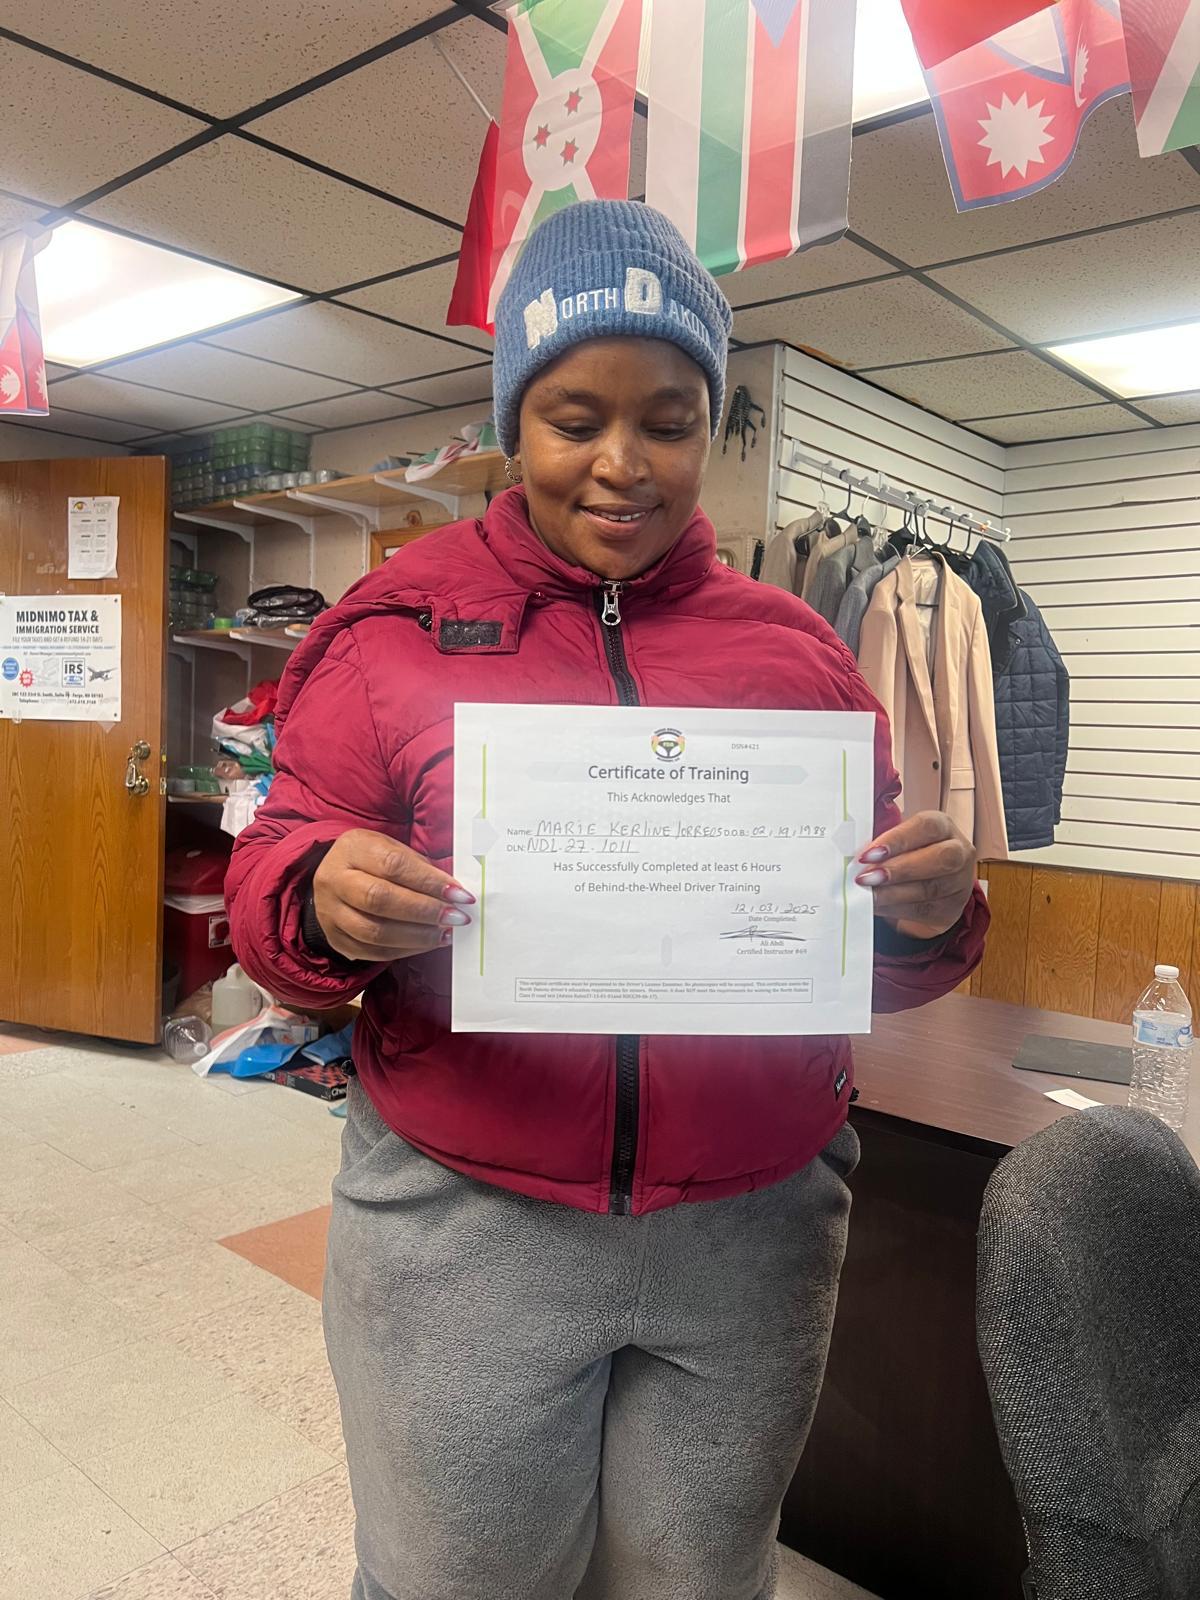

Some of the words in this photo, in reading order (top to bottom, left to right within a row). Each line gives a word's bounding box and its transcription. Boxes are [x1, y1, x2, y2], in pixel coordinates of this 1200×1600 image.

[524, 287, 619, 350] NORTH
[624, 267, 712, 350] DAKO
[16, 610, 66, 623] MIDNIMO
[68, 610, 88, 622] TAX
[90, 609, 99, 622] &
[16, 625, 68, 634] IMMIGRATION
[69, 625, 100, 634] SERVICE
[64, 663, 84, 675] IRS
[588, 765, 666, 780] Certificate
[669, 765, 686, 780] of
[688, 766, 749, 784] Training
[607, 792, 629, 804] This
[631, 792, 706, 806] Acknowledges
[708, 793, 731, 804] That
[553, 862, 574, 872] Has
[576, 861, 640, 874] Successfully
[641, 862, 699, 875] Completed
[701, 863, 712, 872] at
[714, 862, 739, 872] least
[741, 863, 748, 872] 6
[750, 862, 782, 872] Hours
[574, 882, 585, 892] of
[588, 882, 682, 892] Behind-the-Wheel
[684, 883, 716, 892] Driver
[718, 883, 761, 895] Training
